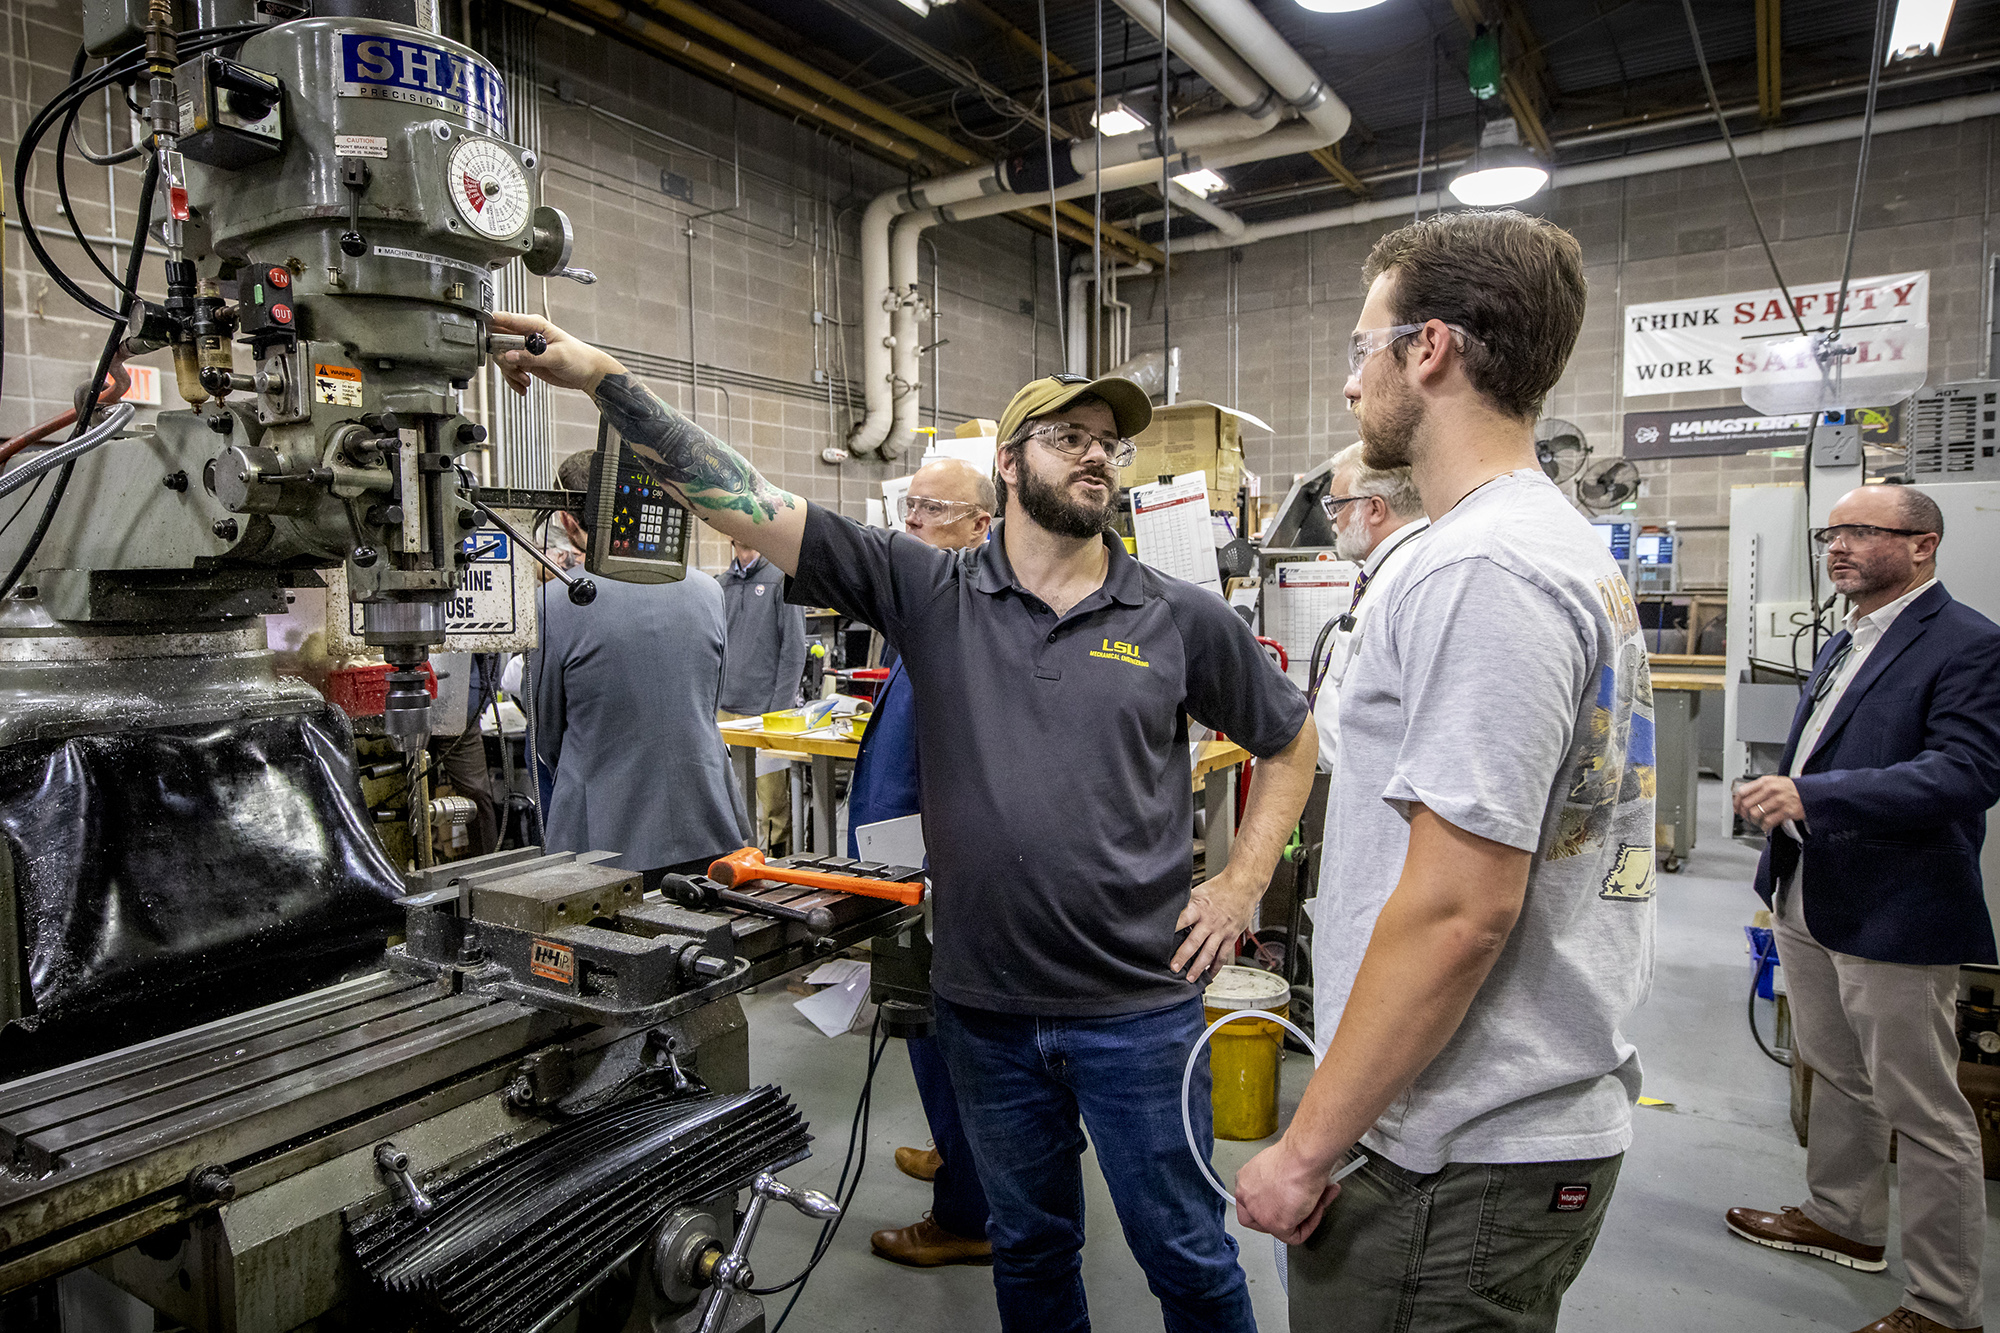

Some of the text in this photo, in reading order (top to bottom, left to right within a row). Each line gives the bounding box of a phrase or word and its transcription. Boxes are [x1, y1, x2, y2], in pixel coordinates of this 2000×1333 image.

[357, 40, 503, 119] SHAR
[360, 87, 444, 108] PRECISION
[384, 248, 414, 258] MACHINE
[416, 252, 433, 261] MUST
[274, 272, 288, 284] IN
[275, 308, 291, 319] OUT
[1632, 282, 1917, 333] THINK SAFETY
[330, 369, 356, 378] WARNING
[1636, 358, 1714, 381] WORK
[1669, 413, 1823, 437] HANGSTERFE
[445, 596, 475, 619] USE
[1102, 638, 1140, 657] LSU
[1089, 650, 1150, 668] MECHANICAL ENGINEERING
[1561, 1194, 1586, 1204] Wrangler
